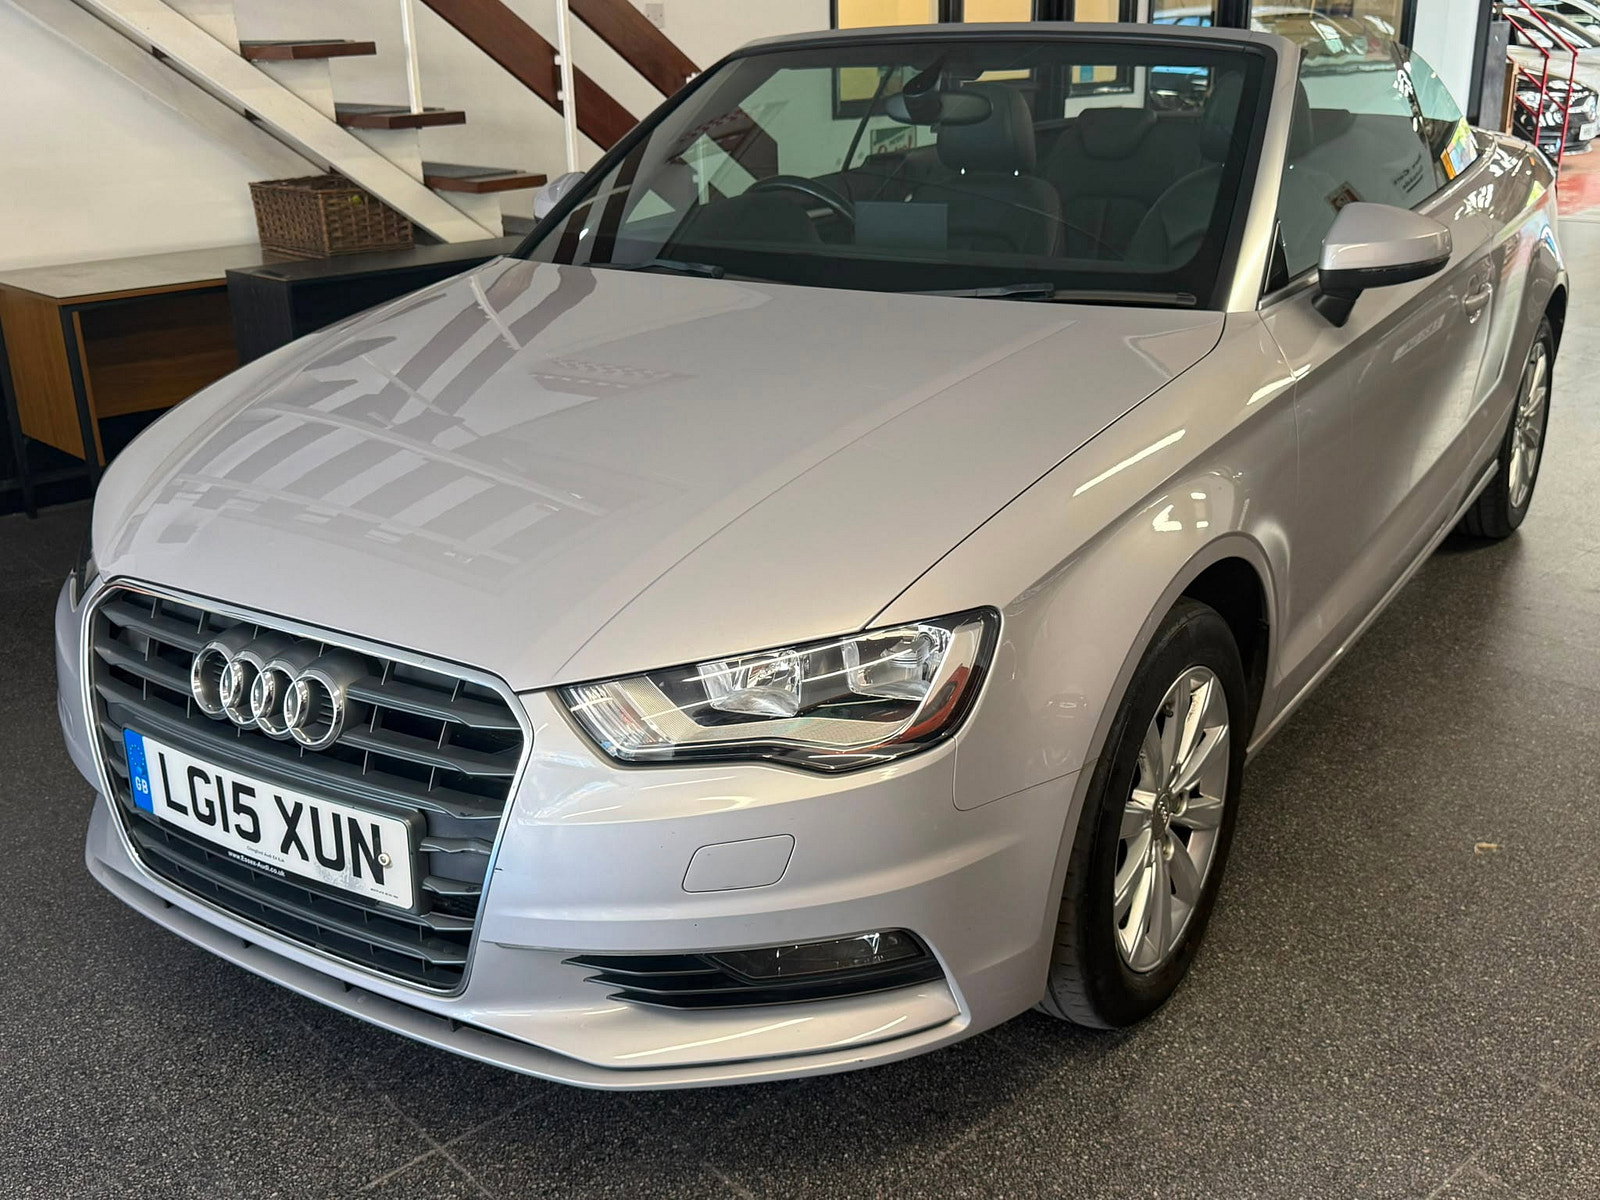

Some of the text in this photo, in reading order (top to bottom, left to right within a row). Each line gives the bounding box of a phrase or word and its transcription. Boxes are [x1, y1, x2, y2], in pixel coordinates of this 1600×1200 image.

[135, 776, 149, 795] GB
[158, 752, 385, 886] LG15 XUN
